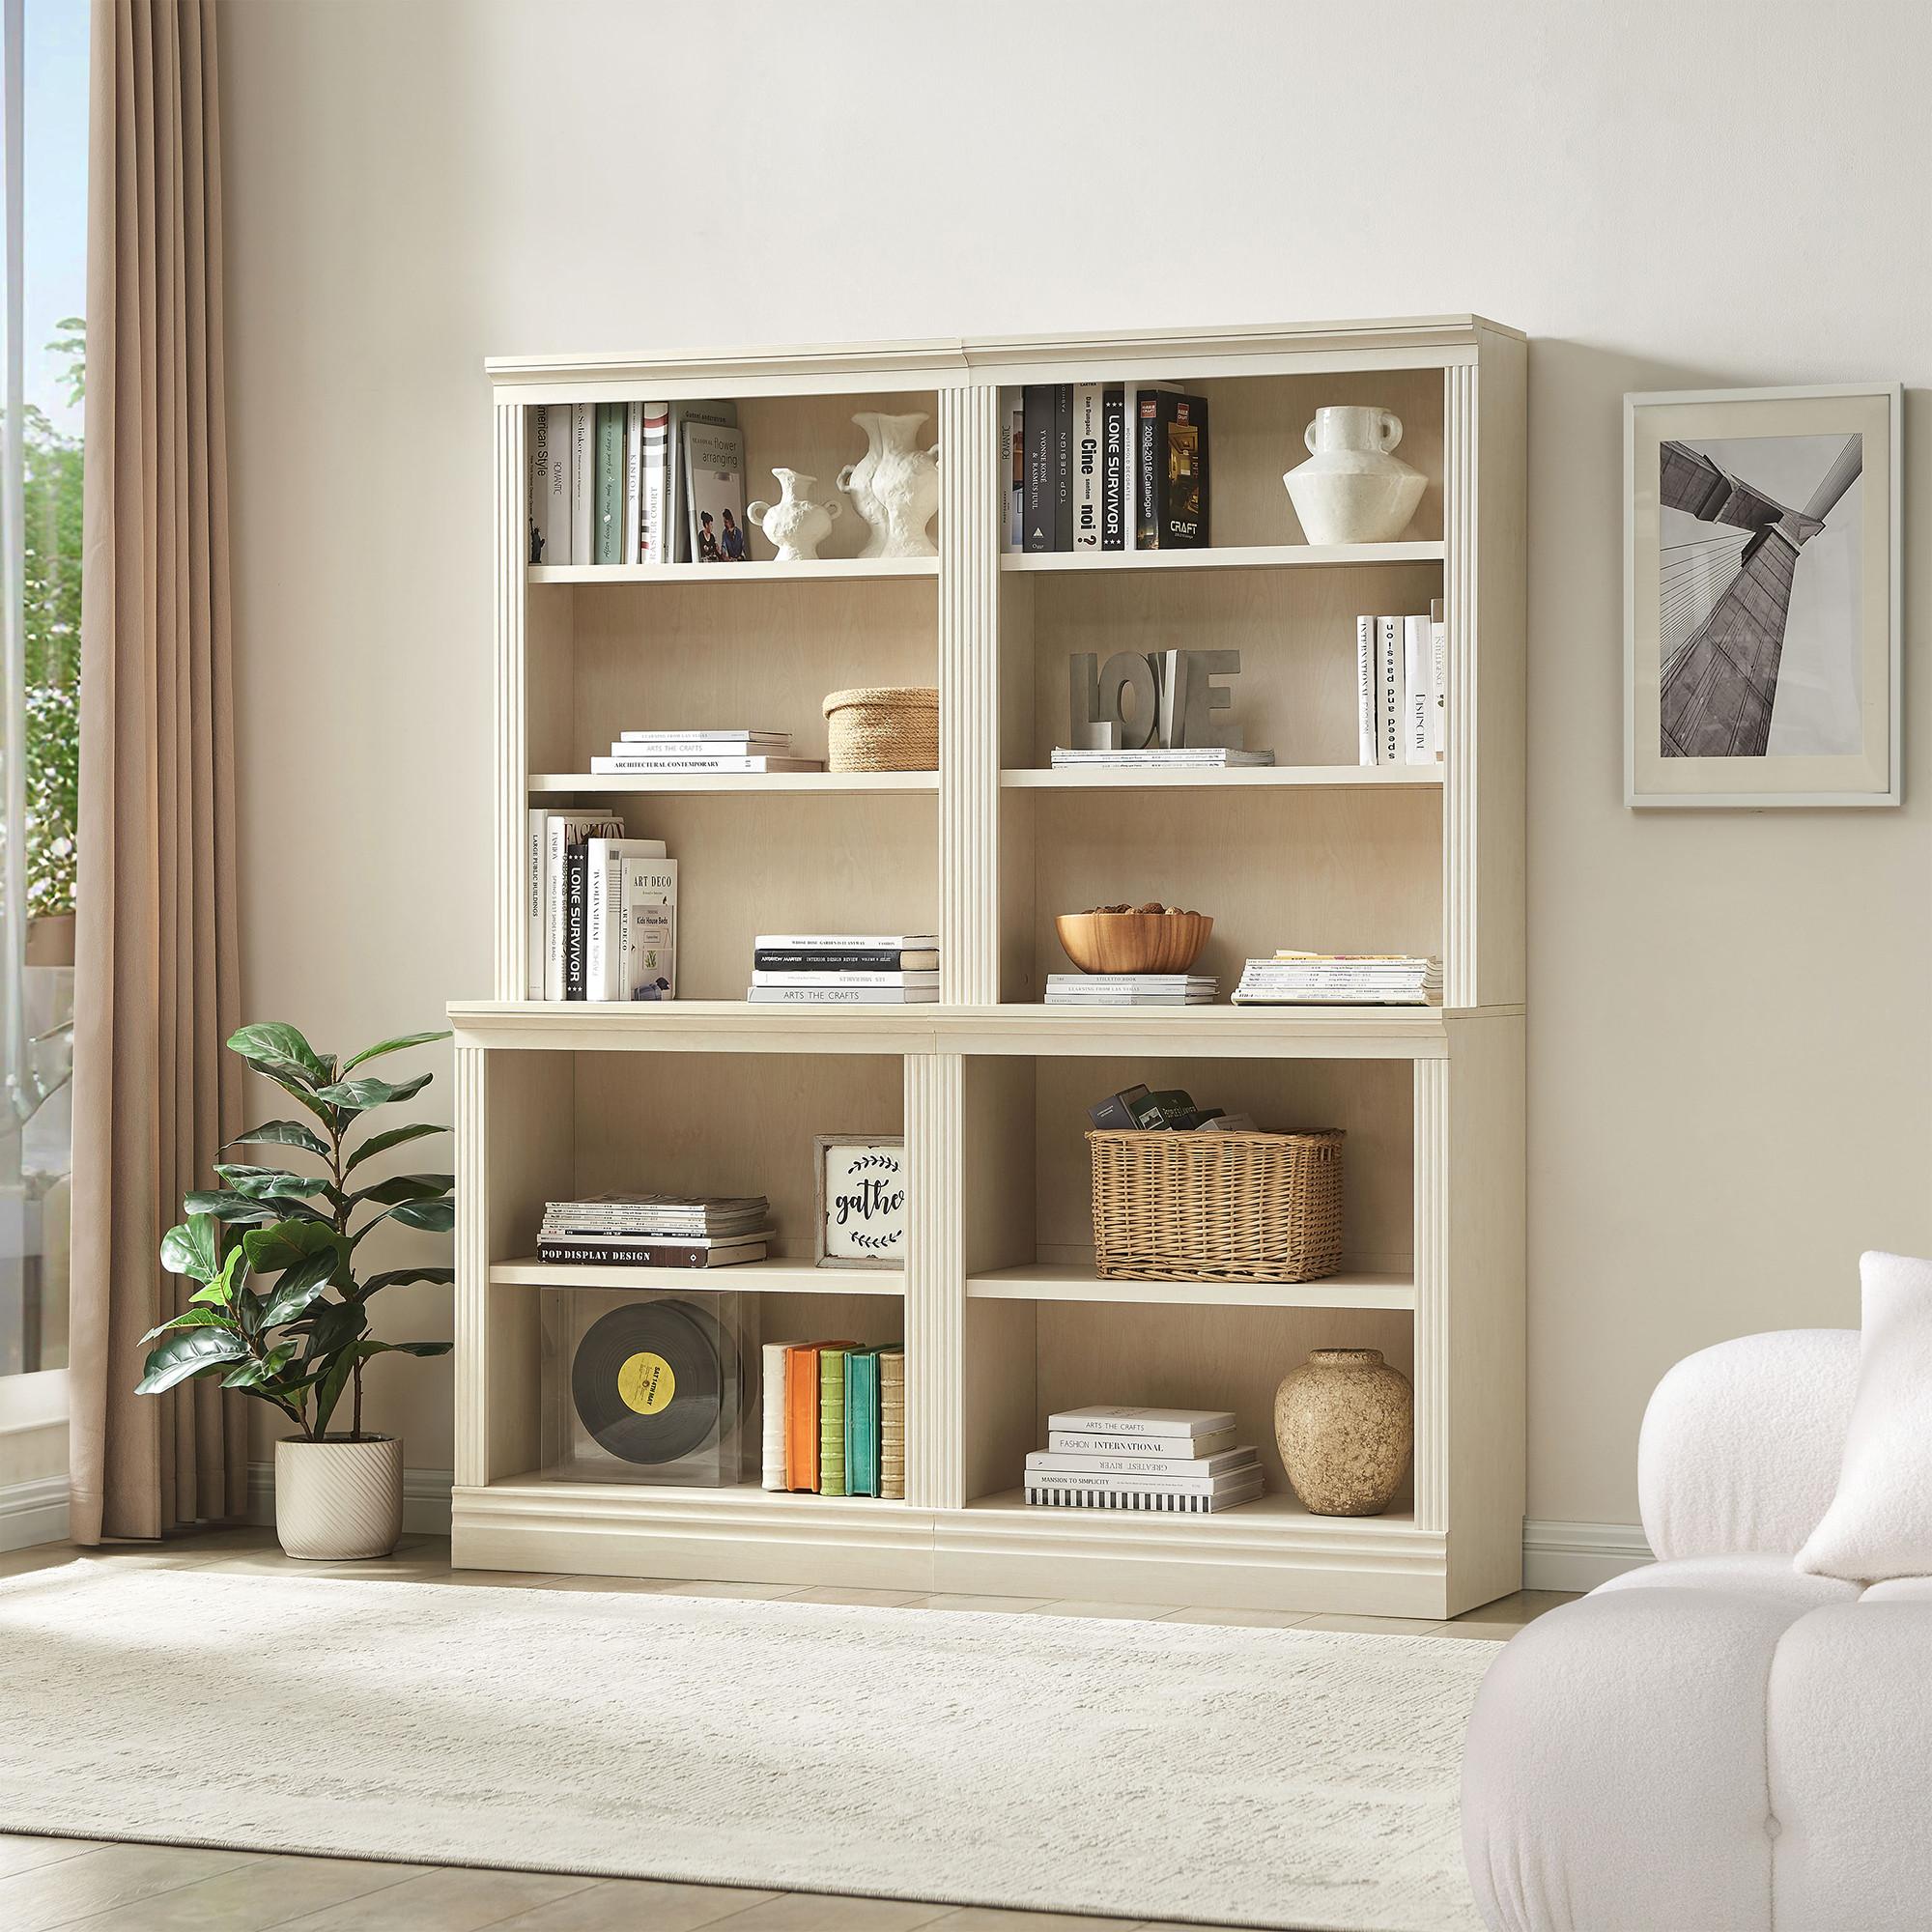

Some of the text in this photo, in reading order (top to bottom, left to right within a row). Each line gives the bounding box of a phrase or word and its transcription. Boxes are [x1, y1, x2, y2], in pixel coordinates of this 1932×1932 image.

[714, 438, 736, 451] flower
[1002, 425, 1011, 459] ROMANTIC
[535, 451, 549, 476] Style
[702, 452, 738, 468] arranging
[1081, 439, 1096, 474] Cine
[554, 462, 562, 495] ROMANTIC
[1107, 414, 1120, 534] LONE SURVIVOR
[1143, 426, 1153, 518] 2008-2018/Catalogue
[1081, 504, 1095, 529] noi
[1170, 520, 1198, 535] CRAFT
[1077, 535, 1096, 546] ?
[1069, 648, 1245, 750] LOVE
[634, 875, 671, 887] ART DECO
[570, 867, 581, 981] LONE SURVIVOR
[783, 991, 860, 1000] ARTS THE CRAFTS
[541, 1249, 650, 1261] POP DISPLAY DESIGN
[646, 1393, 655, 1406] MAY
[1121, 1423, 1145, 1432] CRAFTS
[1060, 1439, 1164, 1452] FASHION INTERNATIONAL
[1099, 1461, 1168, 1471] GREATEST RIVER
[1078, 1477, 1110, 1486] SIMPLICITY
